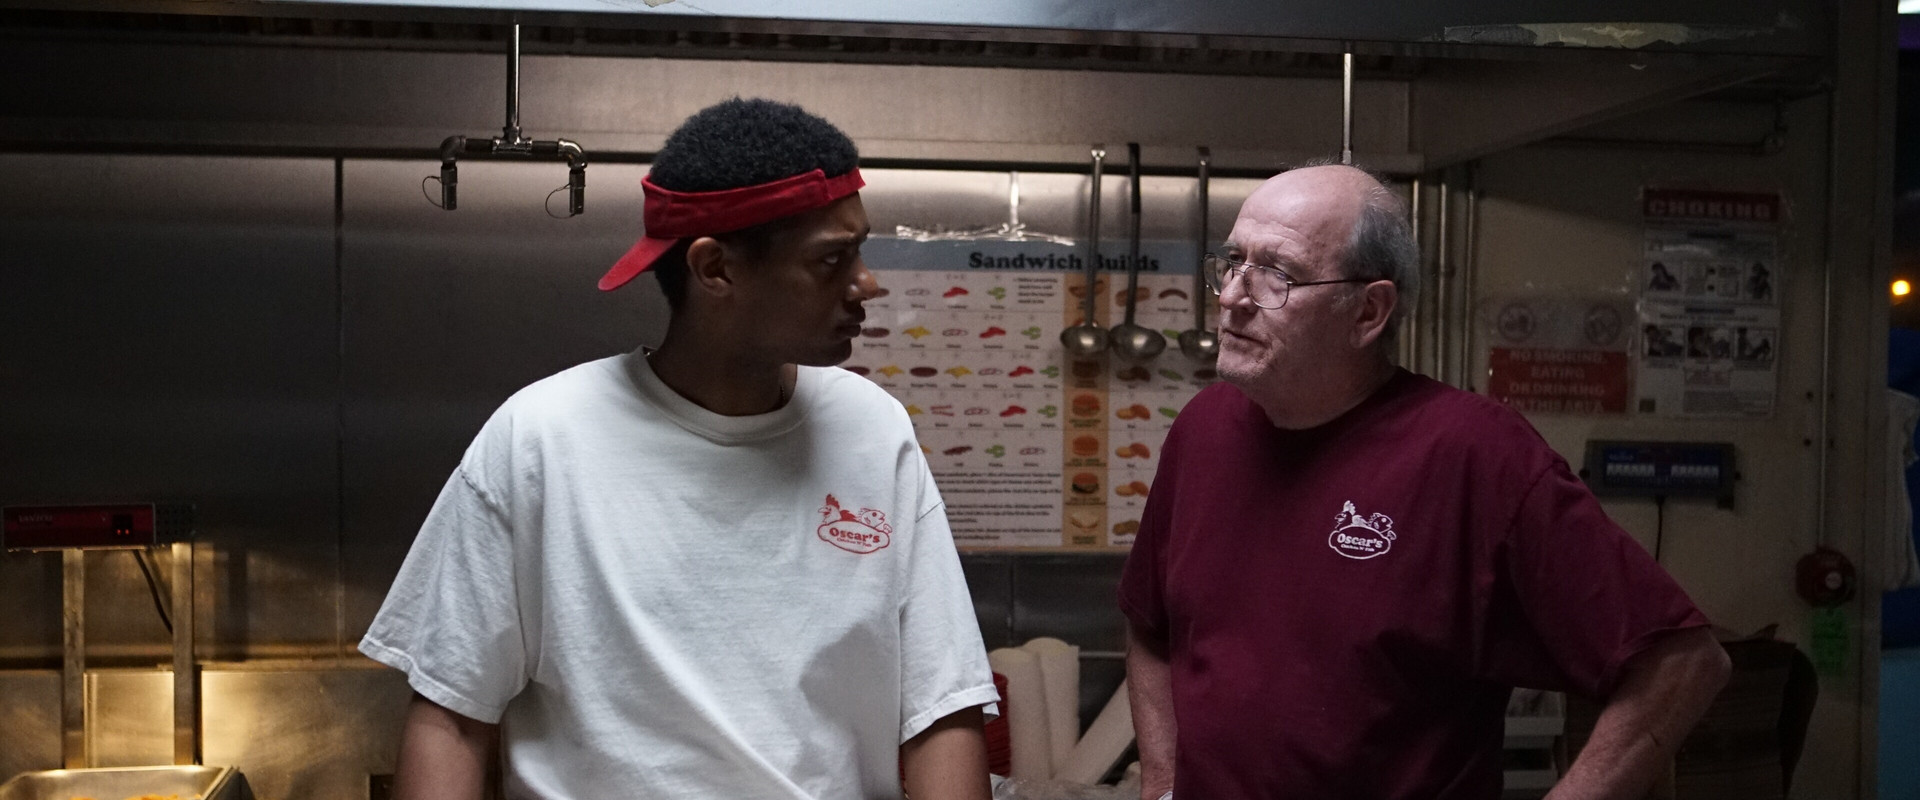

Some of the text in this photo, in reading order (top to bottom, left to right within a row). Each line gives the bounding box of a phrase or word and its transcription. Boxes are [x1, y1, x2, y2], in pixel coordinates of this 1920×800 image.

[1648, 199, 1771, 219] CHOKING
[968, 251, 1083, 270] Sandwich
[1530, 365, 1586, 379] EATING
[1532, 382, 1606, 397] DRINKING
[829, 527, 880, 543] Oscar's
[1337, 533, 1383, 548] Oscar's
